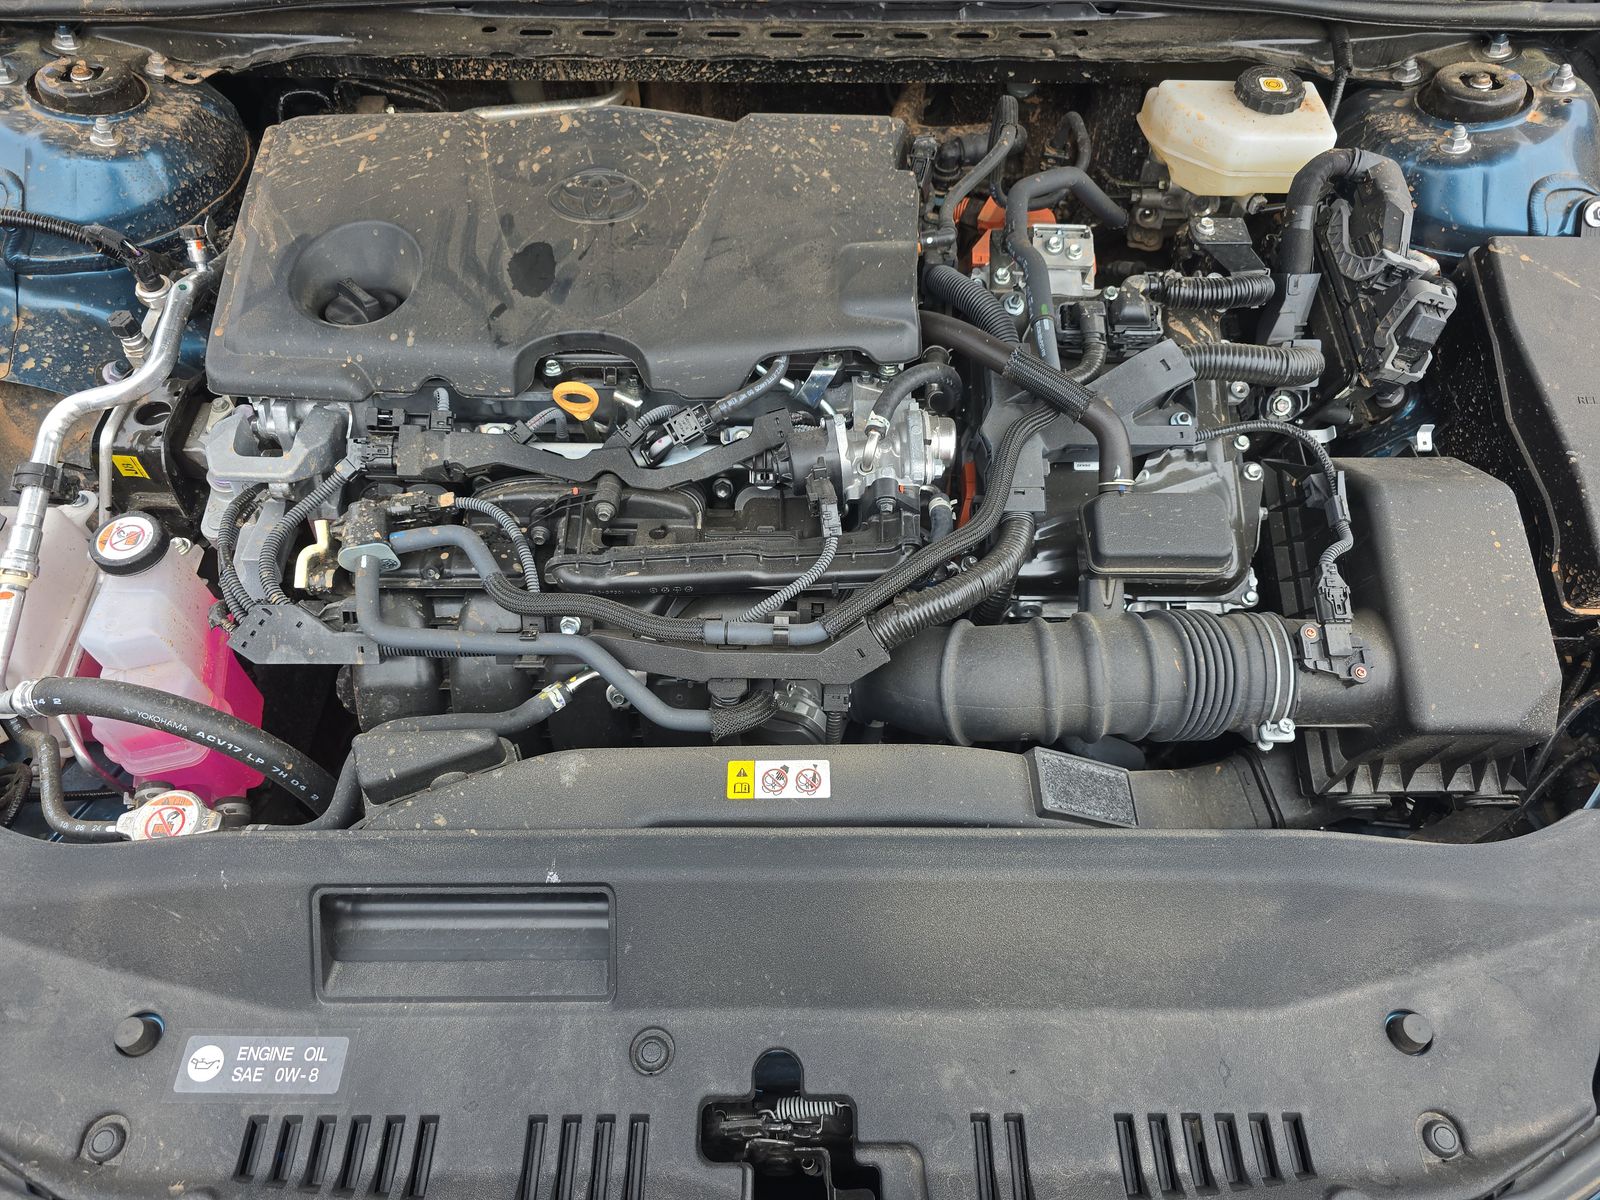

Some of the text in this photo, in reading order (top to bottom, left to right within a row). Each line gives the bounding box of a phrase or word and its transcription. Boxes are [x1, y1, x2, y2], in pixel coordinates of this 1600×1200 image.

[52, 697, 62, 705] 2
[137, 710, 188, 733] YOKOHAMA
[196, 731, 242, 753] ACV17
[246, 753, 265, 764] LP
[271, 765, 288, 778] 7H
[237, 1046, 328, 1062] ENGINE OIL
[231, 1067, 319, 1083] SAE 0W-8
